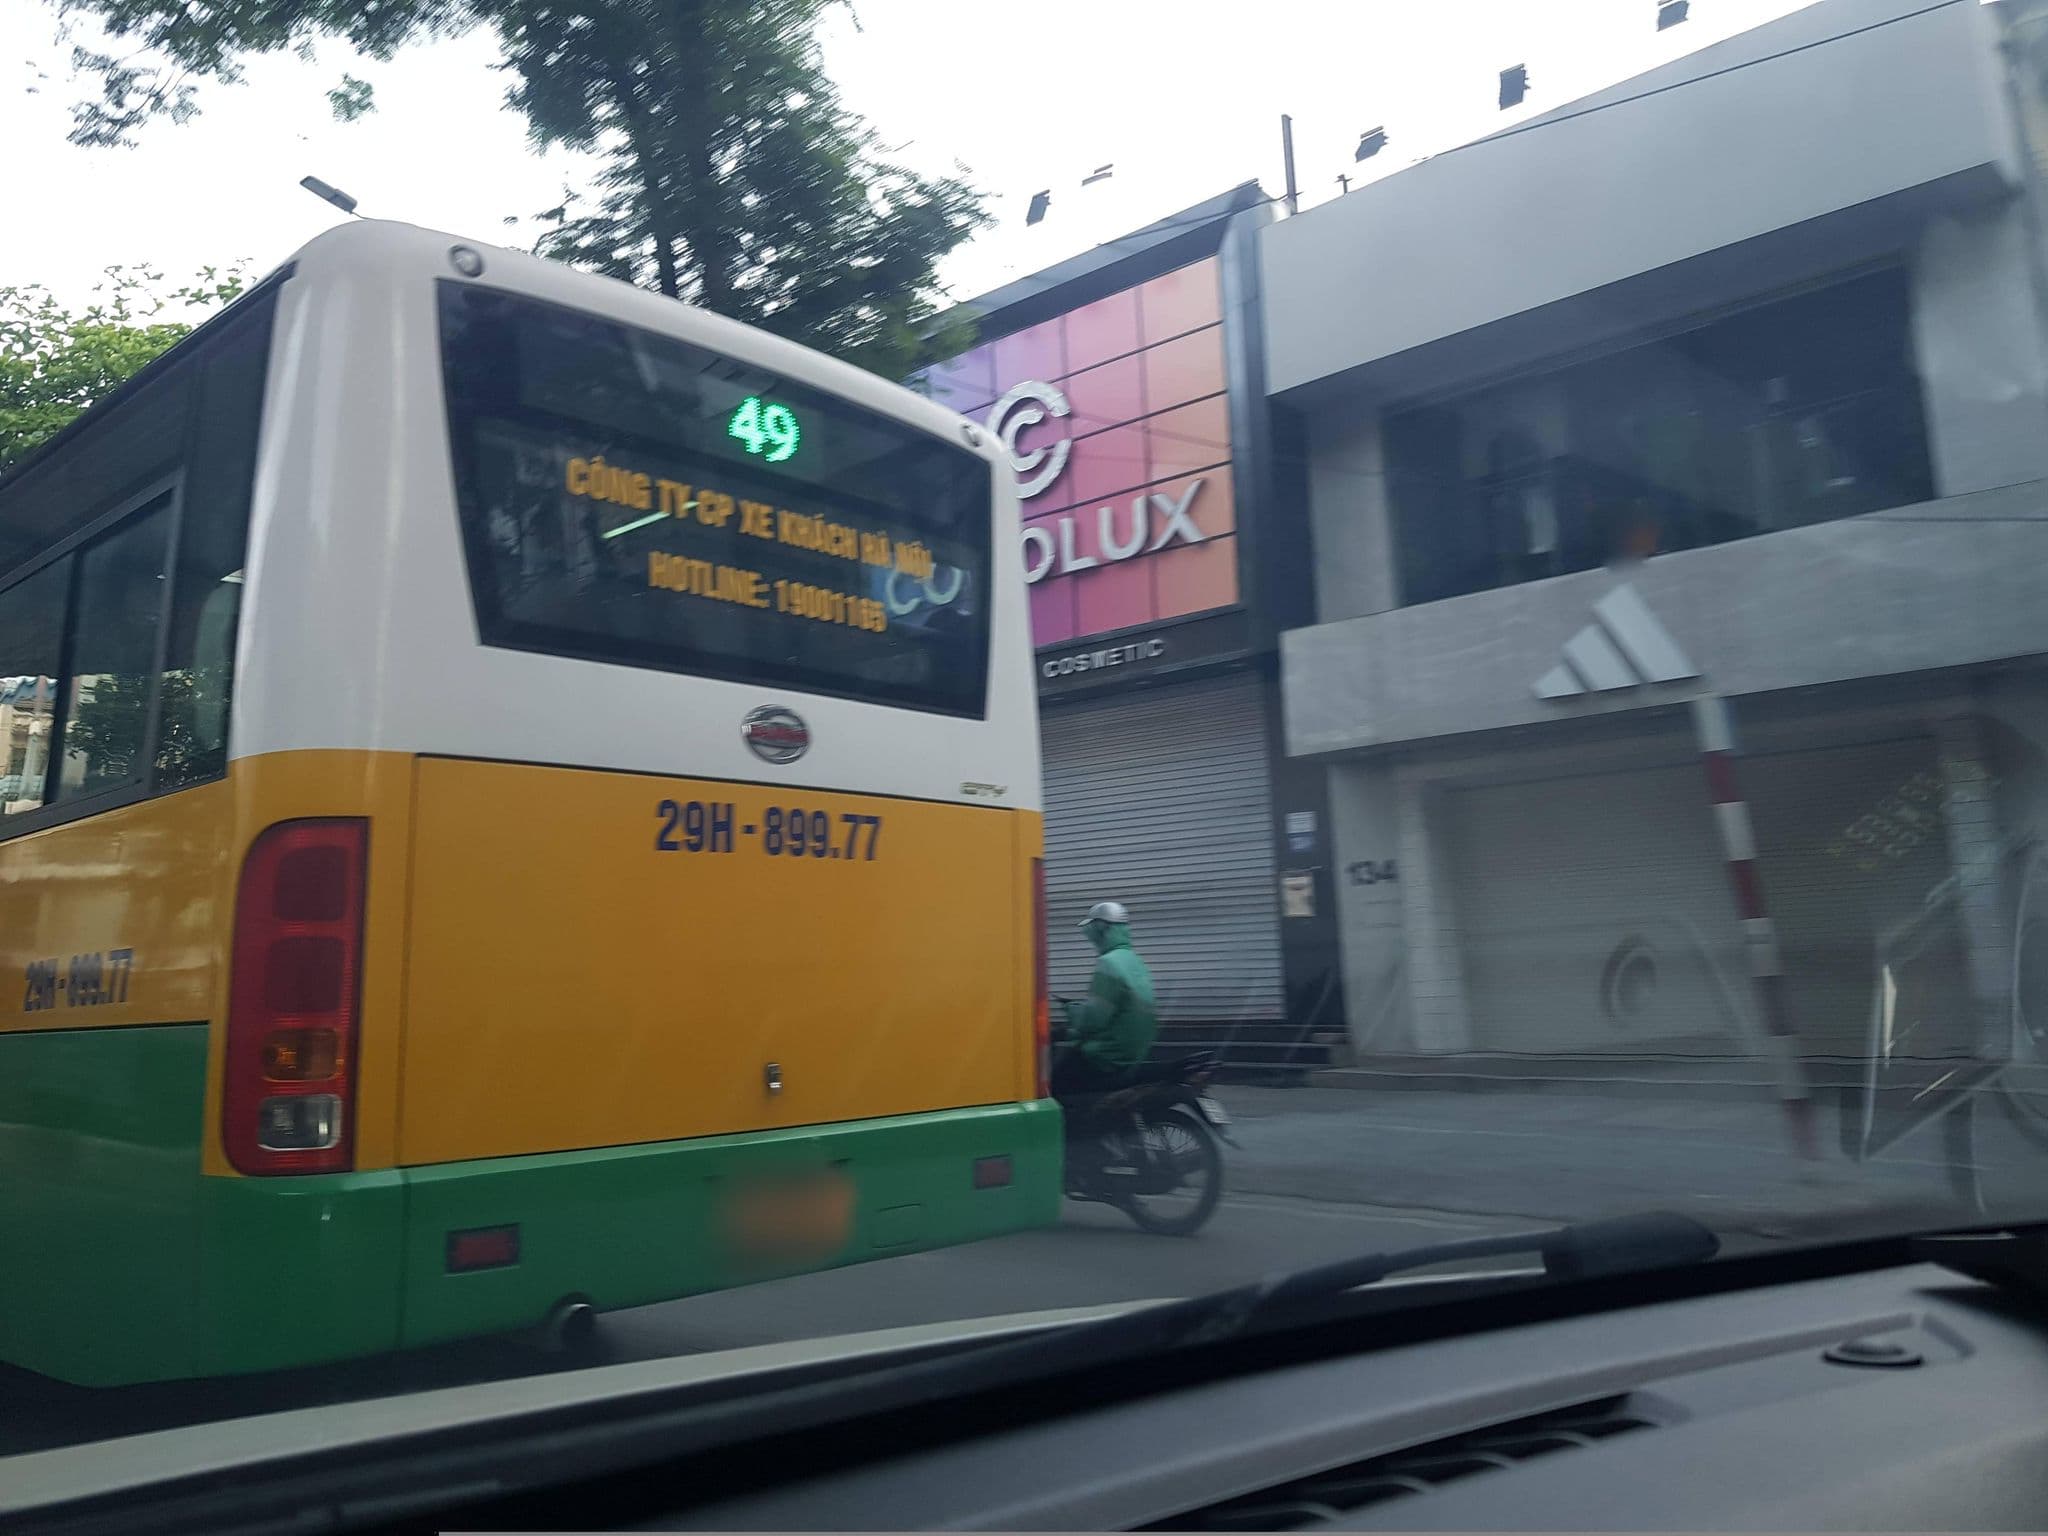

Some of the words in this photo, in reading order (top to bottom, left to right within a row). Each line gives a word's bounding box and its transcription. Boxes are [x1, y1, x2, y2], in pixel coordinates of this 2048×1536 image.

[728, 397, 800, 462] 49
[655, 479, 692, 519] TY
[697, 489, 734, 528] CP
[739, 500, 774, 540] XE
[1043, 638, 1166, 678] COSMETIC
